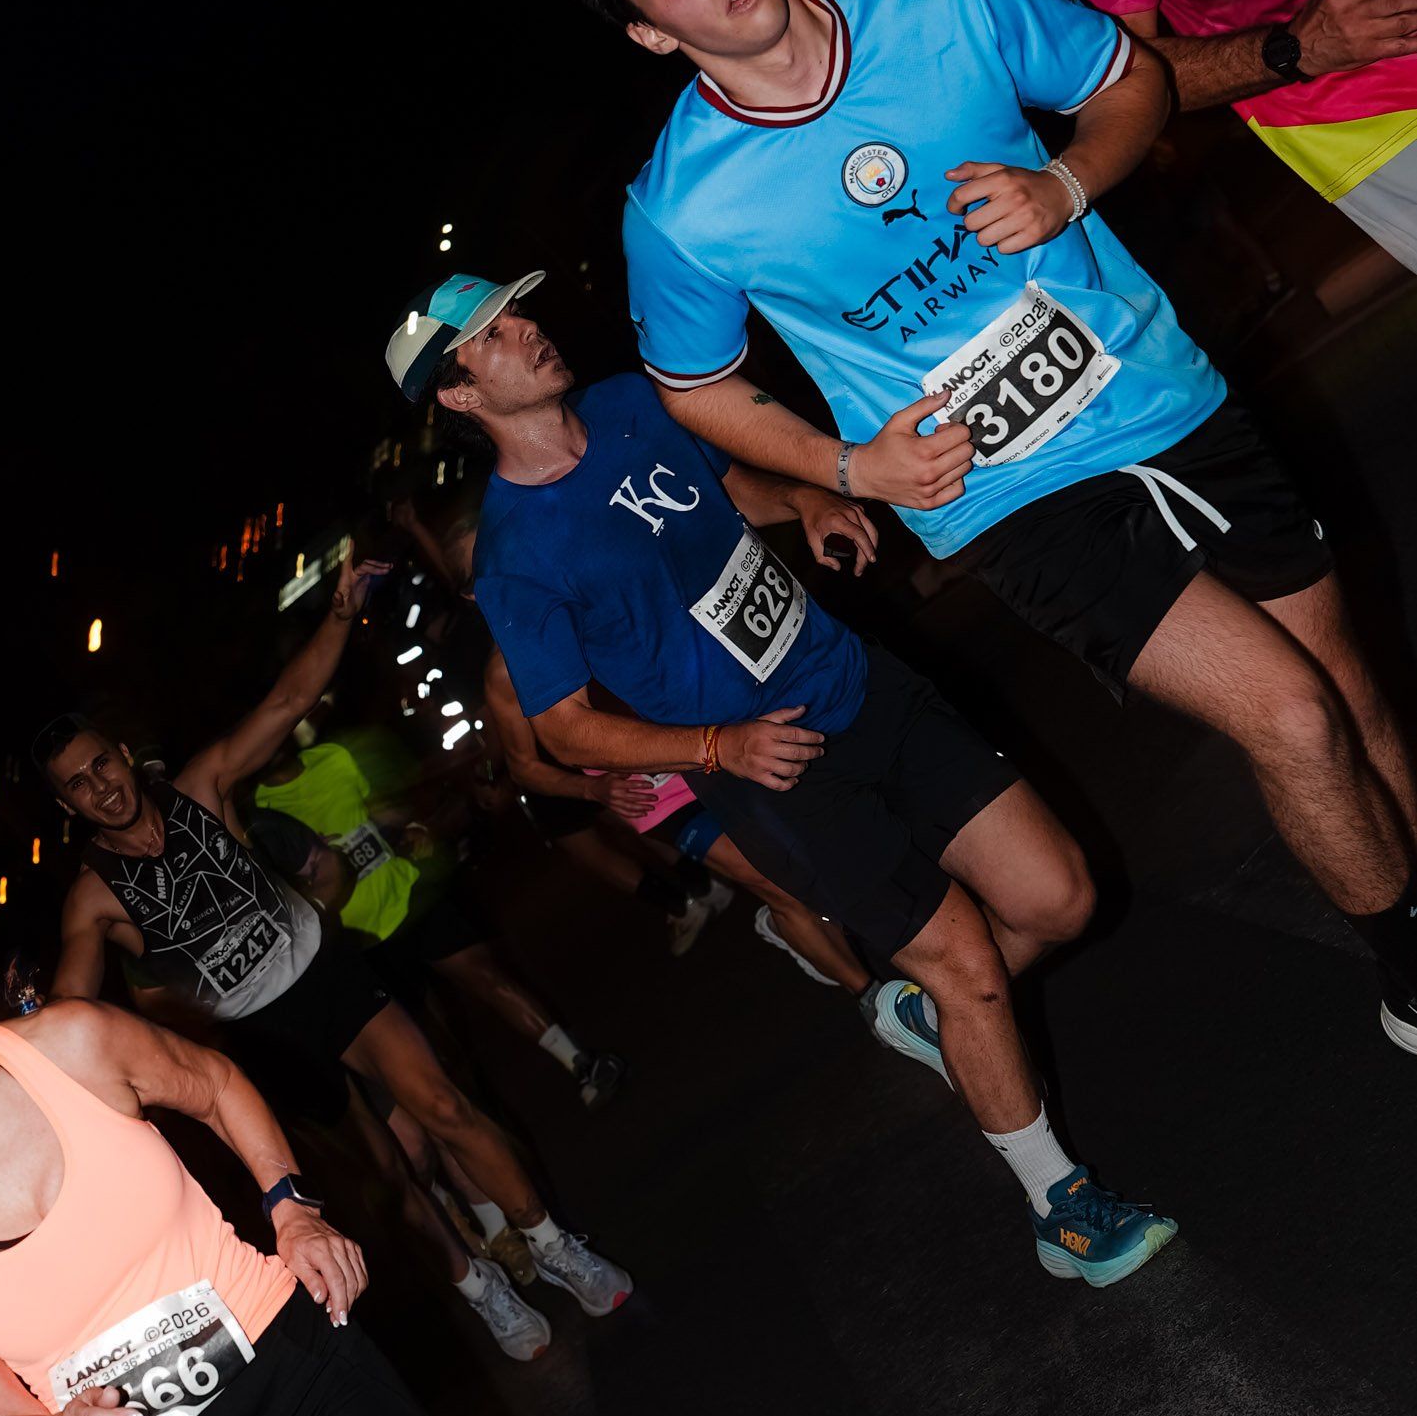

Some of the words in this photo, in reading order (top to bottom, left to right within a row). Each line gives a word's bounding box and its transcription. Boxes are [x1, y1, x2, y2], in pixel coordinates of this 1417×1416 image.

[849, 148, 889, 185] MANCHESTER
[881, 183, 898, 199] CITY
[900, 247, 1001, 343] AIRWAY
[965, 327, 1084, 445] 3180
[609, 463, 700, 535] KC
[706, 575, 745, 620] LANOCT.
[743, 565, 791, 639] 628
[213, 923, 274, 993] 1247
[1066, 1176, 1089, 1196] HOKA
[1059, 1227, 1092, 1257] HOKA
[65, 1340, 135, 1388] LANOCT.
[142, 1300, 210, 1344] ©2026
[124, 1346, 220, 1410] 66
